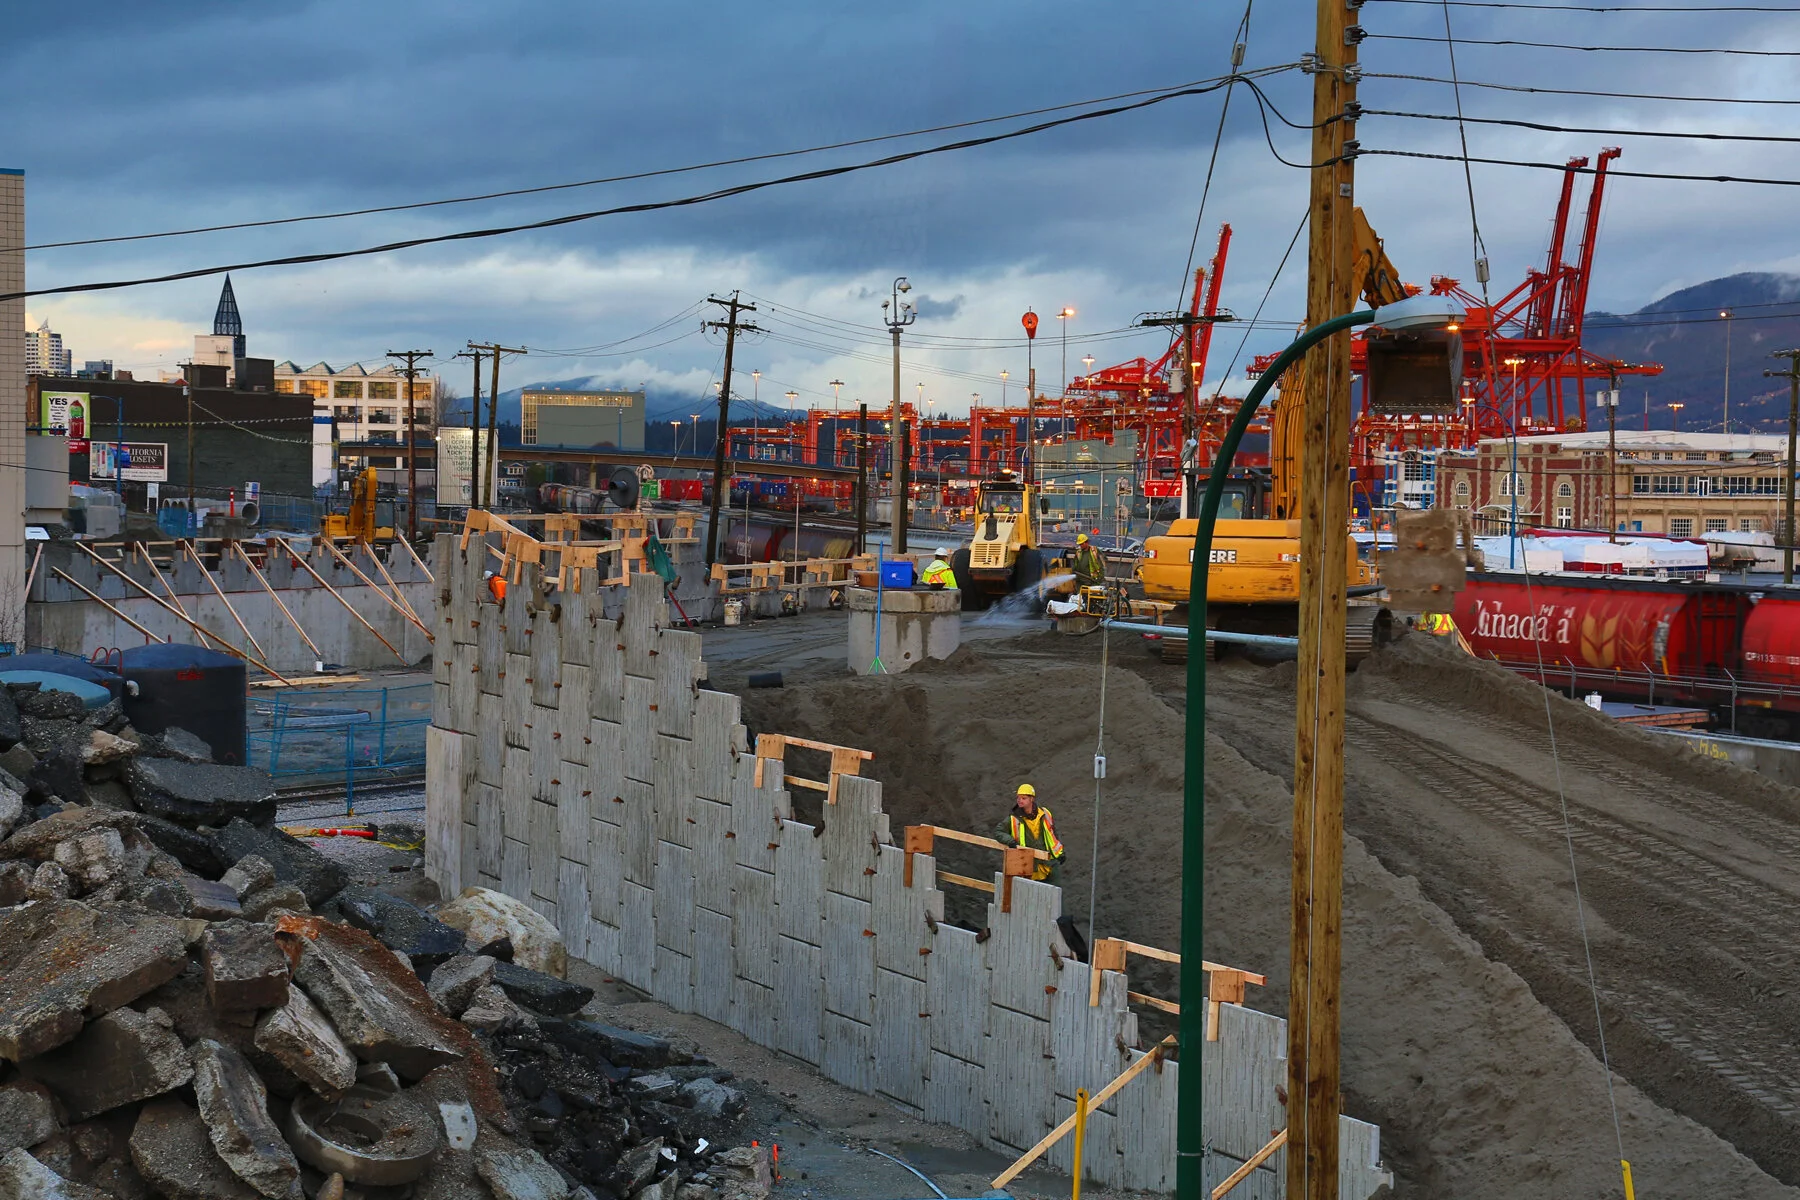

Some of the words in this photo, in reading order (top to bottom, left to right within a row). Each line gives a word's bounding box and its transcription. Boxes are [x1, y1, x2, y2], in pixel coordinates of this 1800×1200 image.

[48, 397, 68, 405] YES
[127, 447, 163, 457] LIFORNIA
[129, 455, 156, 463] LOSETS
[1189, 550, 1237, 563] ERE
